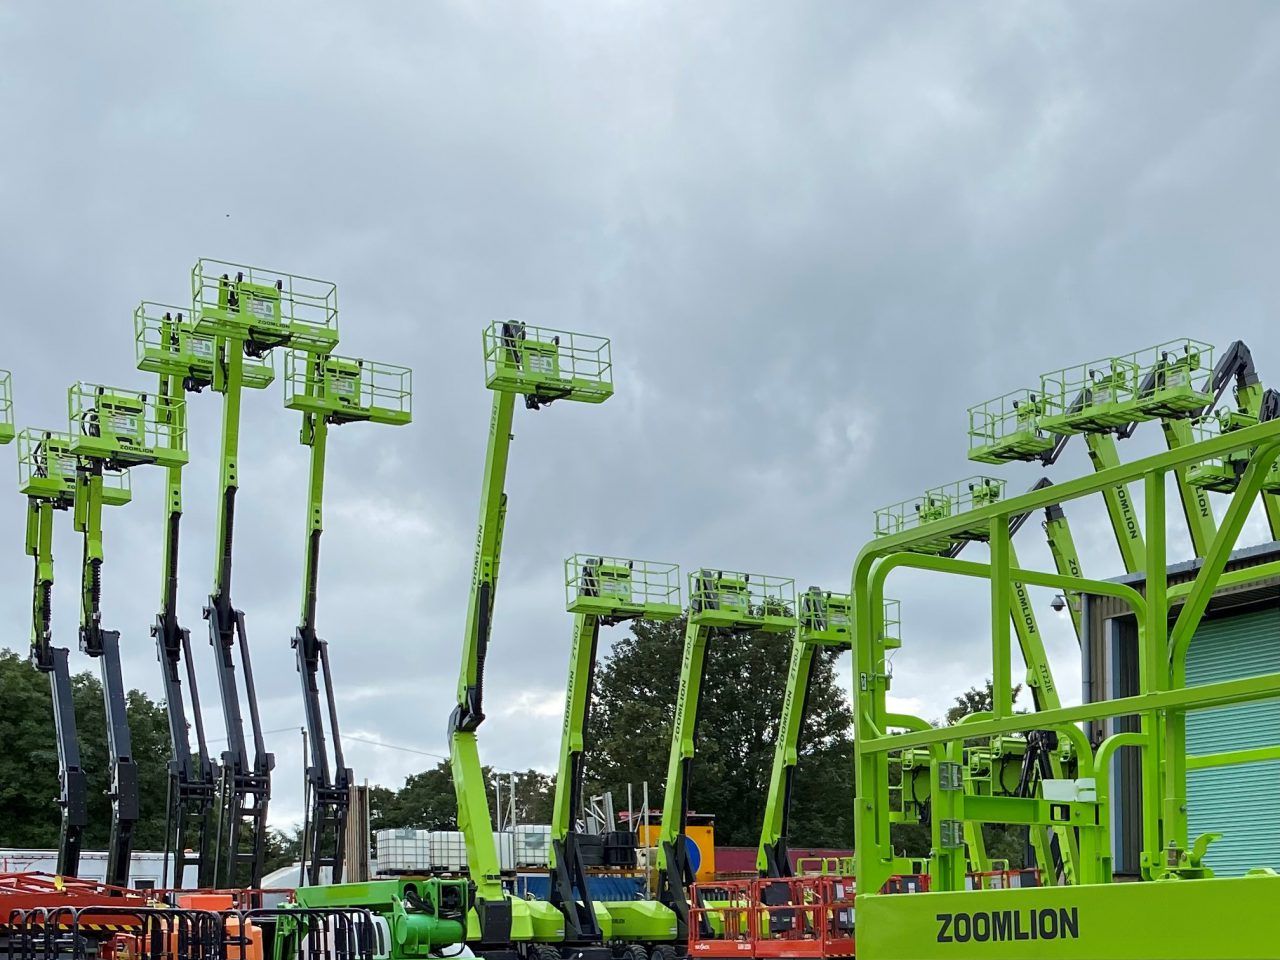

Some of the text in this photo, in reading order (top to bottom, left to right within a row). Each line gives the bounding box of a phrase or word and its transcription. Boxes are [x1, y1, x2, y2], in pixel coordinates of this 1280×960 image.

[119, 444, 155, 454] ZOOMLION
[1117, 484, 1138, 540] OMLION
[1196, 486, 1209, 518] LION
[471, 524, 483, 594] ZOOMLION
[564, 671, 575, 736] ZOOMLION
[674, 680, 687, 743] ZOOMLION
[778, 691, 793, 751] ZOOMLION
[936, 907, 1079, 943] ZOOMLION
